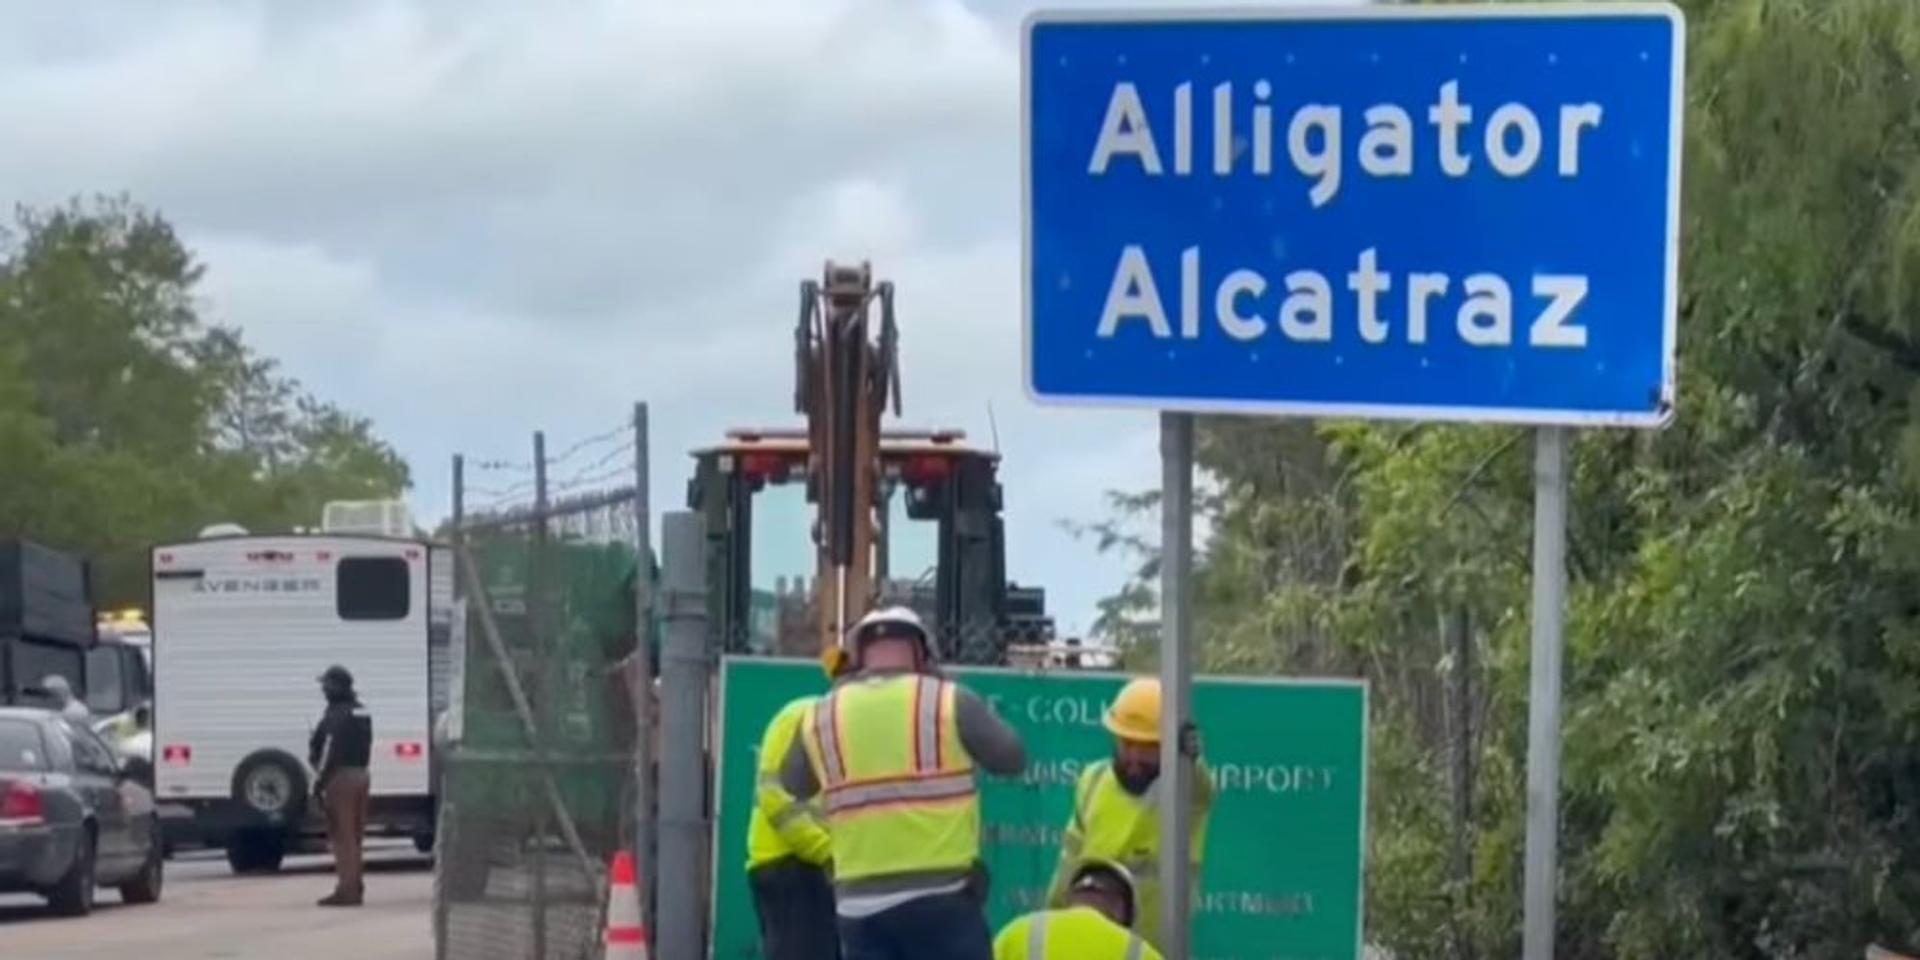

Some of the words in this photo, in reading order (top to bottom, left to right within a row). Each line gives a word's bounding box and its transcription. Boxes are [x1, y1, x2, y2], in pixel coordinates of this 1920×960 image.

[1088, 79, 1602, 208] Alligator
[1096, 245, 1589, 348] Alcatraz
[192, 578, 320, 594] AVENGER
